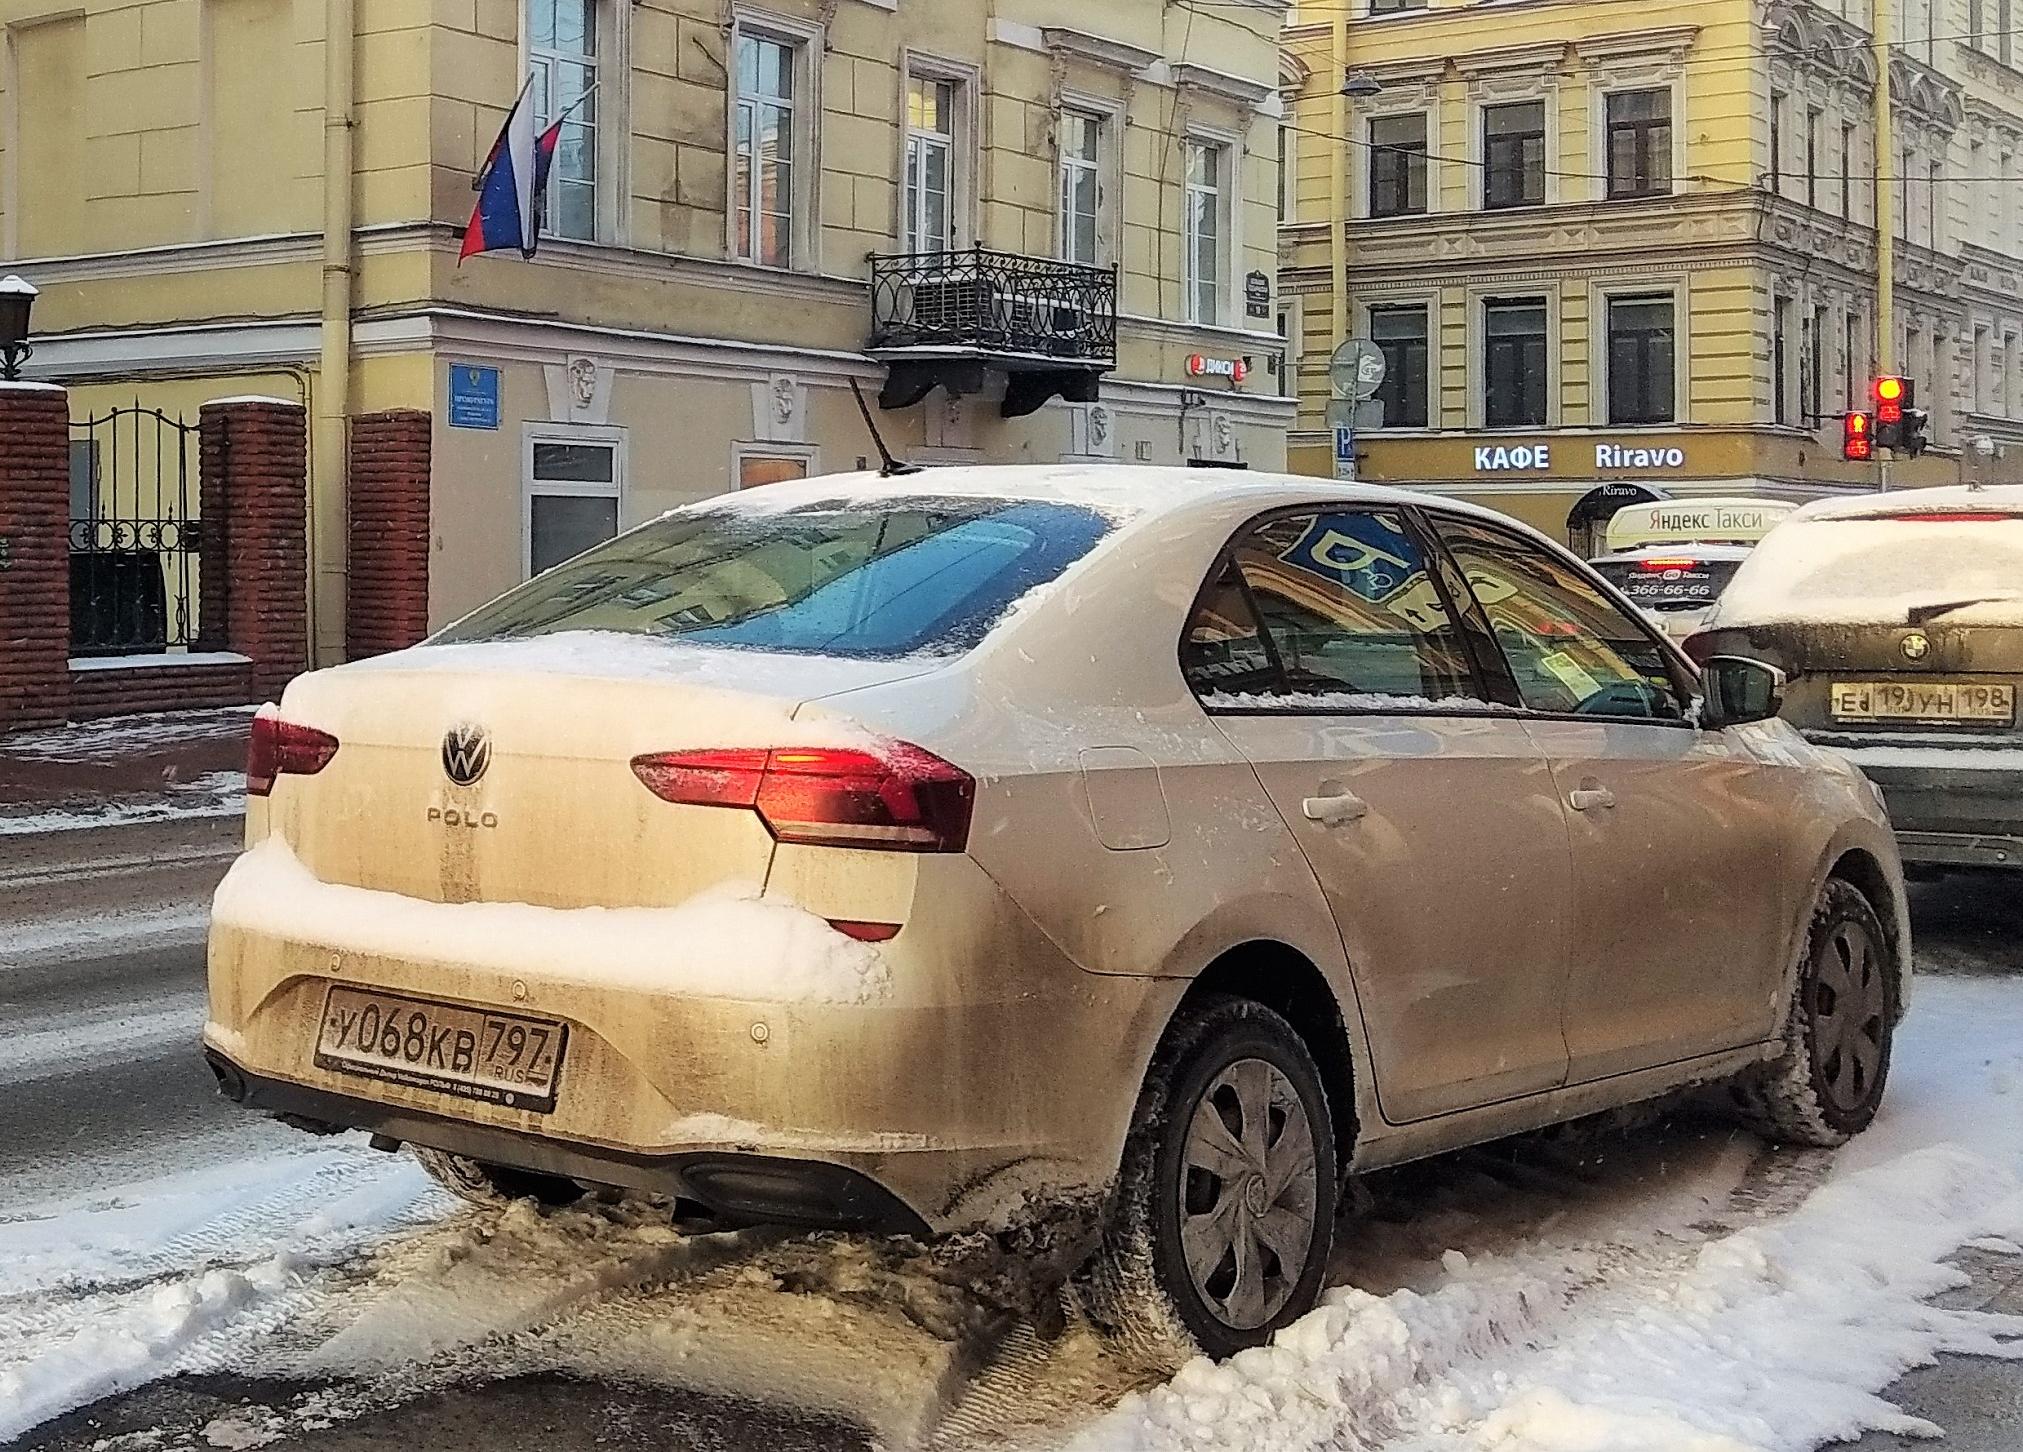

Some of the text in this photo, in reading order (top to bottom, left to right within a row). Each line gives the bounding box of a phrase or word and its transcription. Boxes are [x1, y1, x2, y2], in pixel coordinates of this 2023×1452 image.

[1474, 444, 1684, 470] КАФЕ Riravo
[1602, 485, 1637, 496] Riravo
[1650, 507, 1762, 531] Яндекс Такси
[1631, 585, 1710, 595] 366-66-66
[427, 807, 498, 828] POLO
[494, 1065, 525, 1084] RUS
